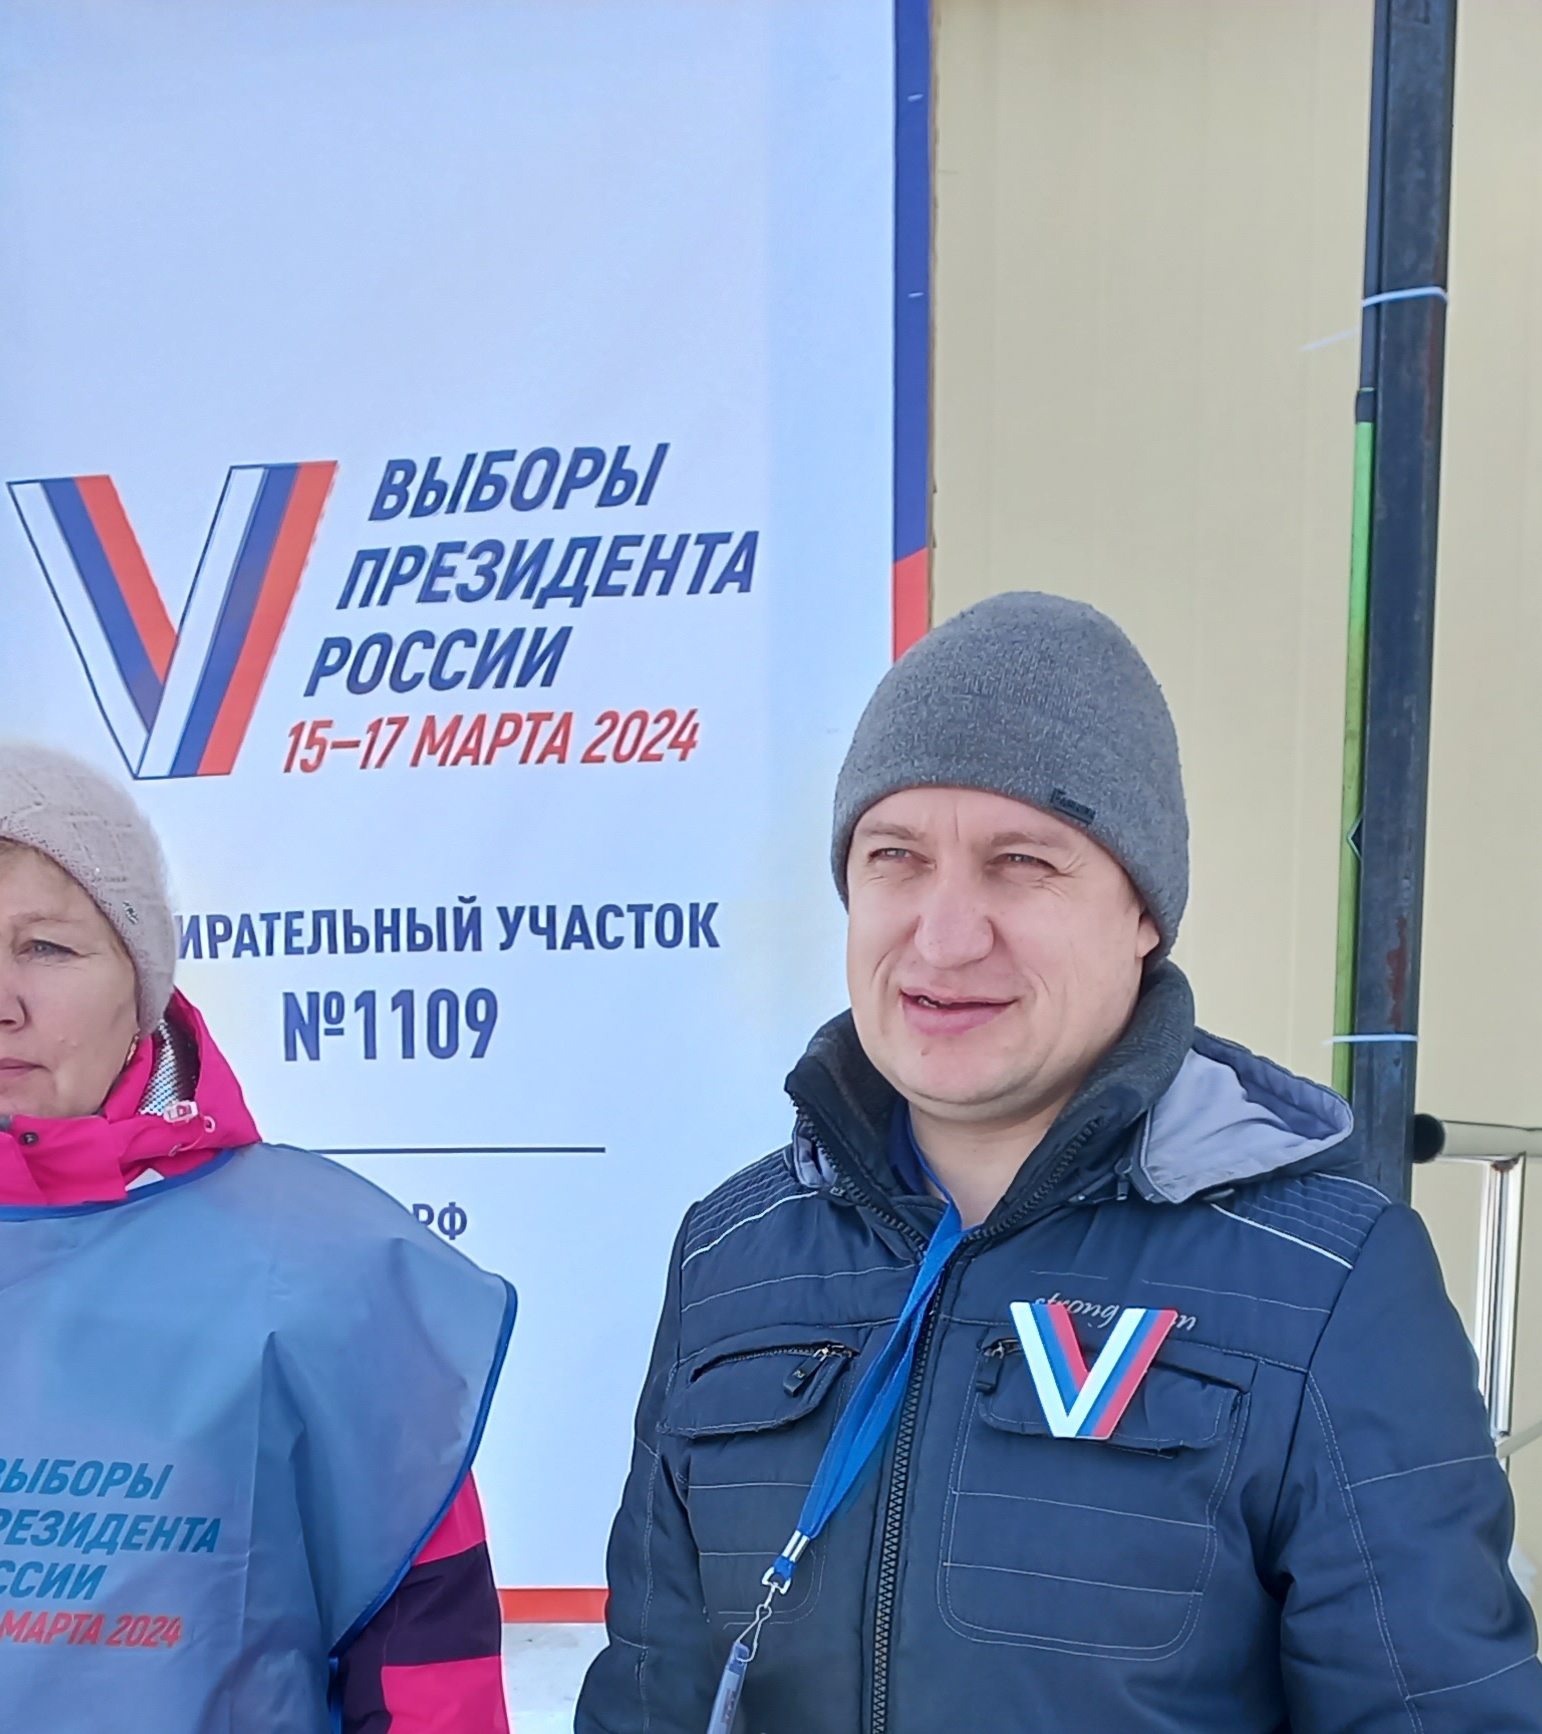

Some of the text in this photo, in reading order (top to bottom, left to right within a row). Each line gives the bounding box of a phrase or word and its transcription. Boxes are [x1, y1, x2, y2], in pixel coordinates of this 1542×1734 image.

[368, 442, 670, 522] ВЫБОРЫ
[335, 530, 759, 610] ПРЕЗИДЕНТА
[303, 626, 573, 697] РОССИИ
[409, 711, 574, 768] МАРТА
[579, 708, 700, 764] 2024
[176, 895, 720, 959] ИРАТЕЛЬНЫЙ УЧАСТОК
[282, 987, 499, 1062] №1109
[412, 1201, 468, 1241] РФ
[105, 1613, 181, 1648] 2024
